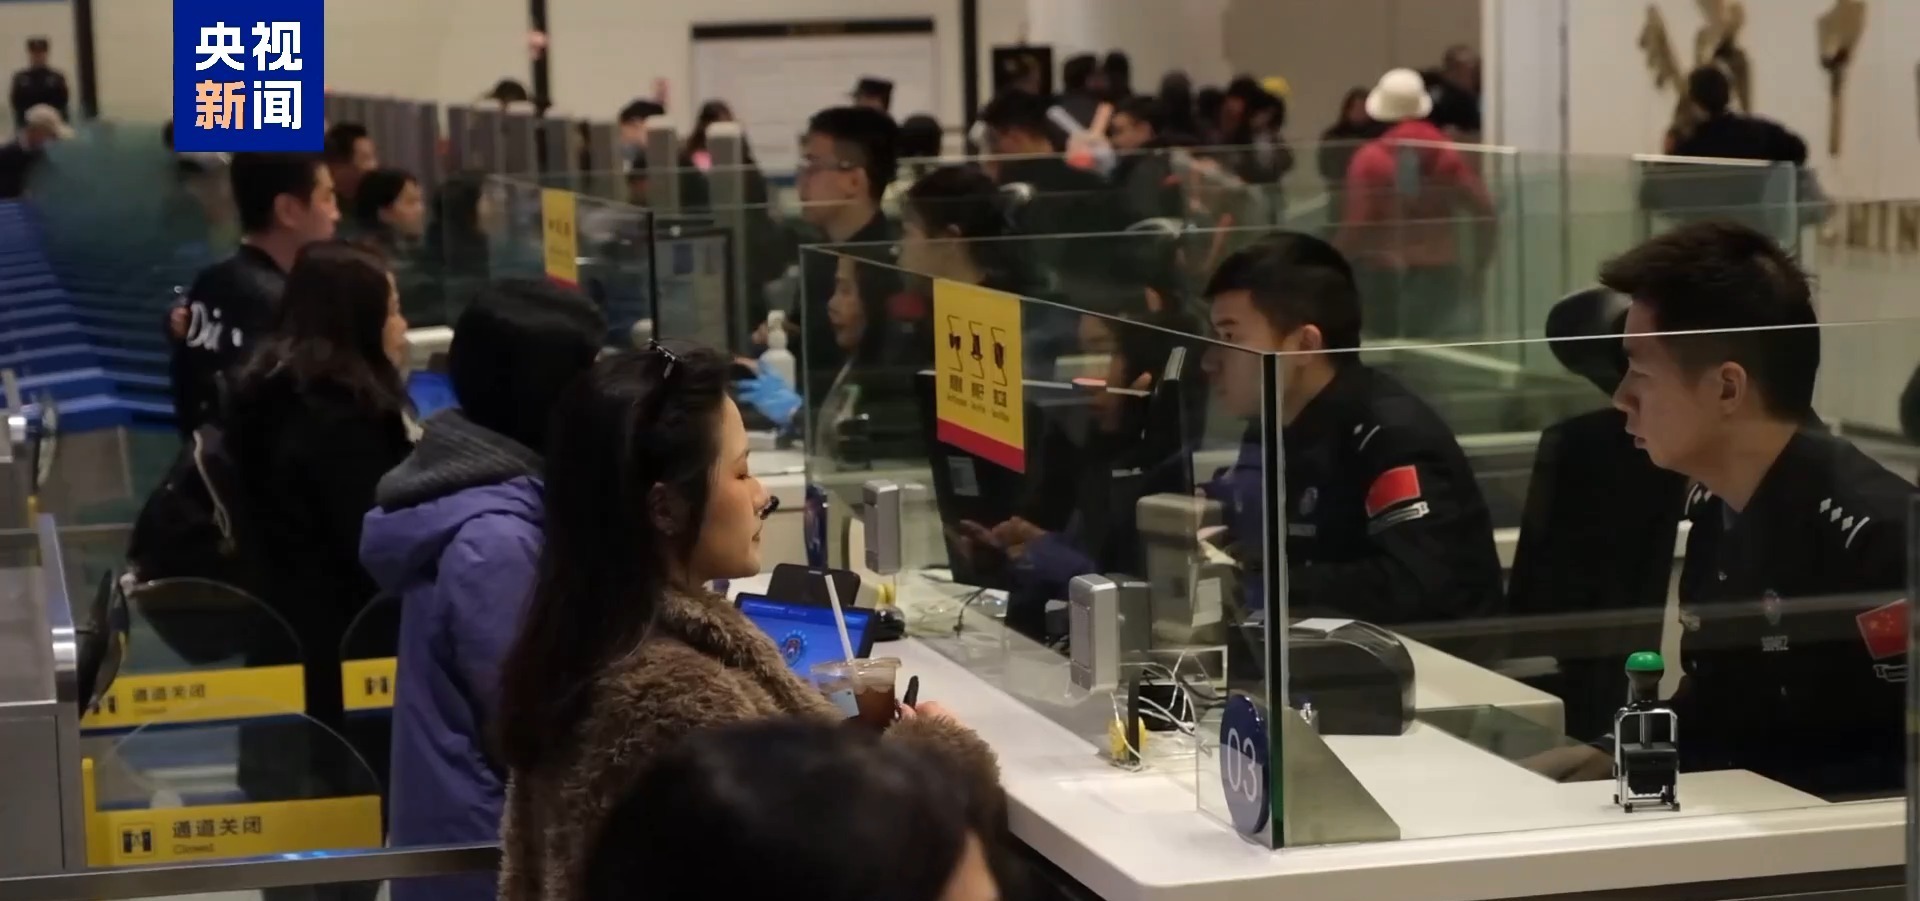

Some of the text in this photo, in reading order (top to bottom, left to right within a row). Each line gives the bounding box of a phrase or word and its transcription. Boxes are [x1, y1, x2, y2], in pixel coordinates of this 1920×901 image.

[132, 684, 205, 703] 通道关闭
[1226, 727, 1258, 802] 03
[172, 816, 262, 838] 通道关闭
